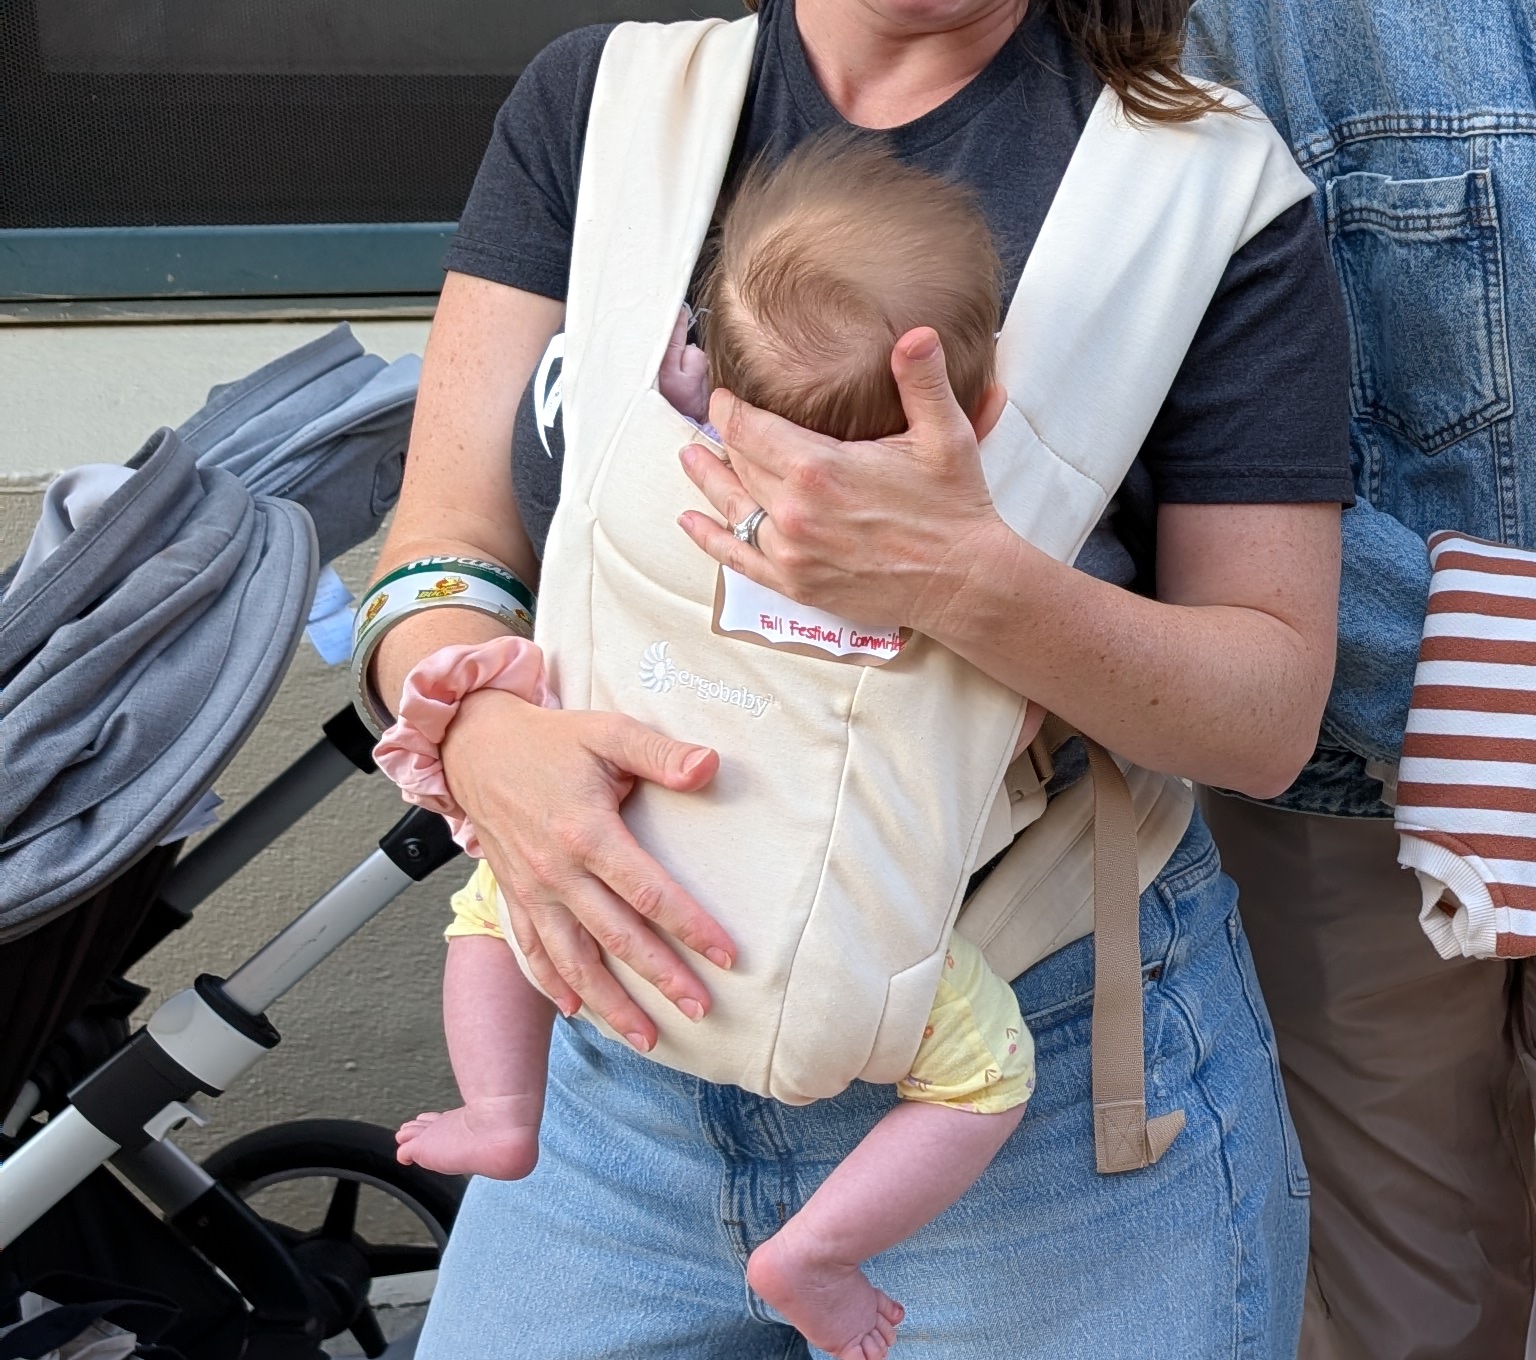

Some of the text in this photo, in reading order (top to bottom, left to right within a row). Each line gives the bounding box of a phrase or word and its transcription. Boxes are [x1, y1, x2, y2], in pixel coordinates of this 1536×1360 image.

[759, 614, 783, 635] Fall
[788, 620, 844, 649] Festival
[678, 669, 768, 718] ergobaby
